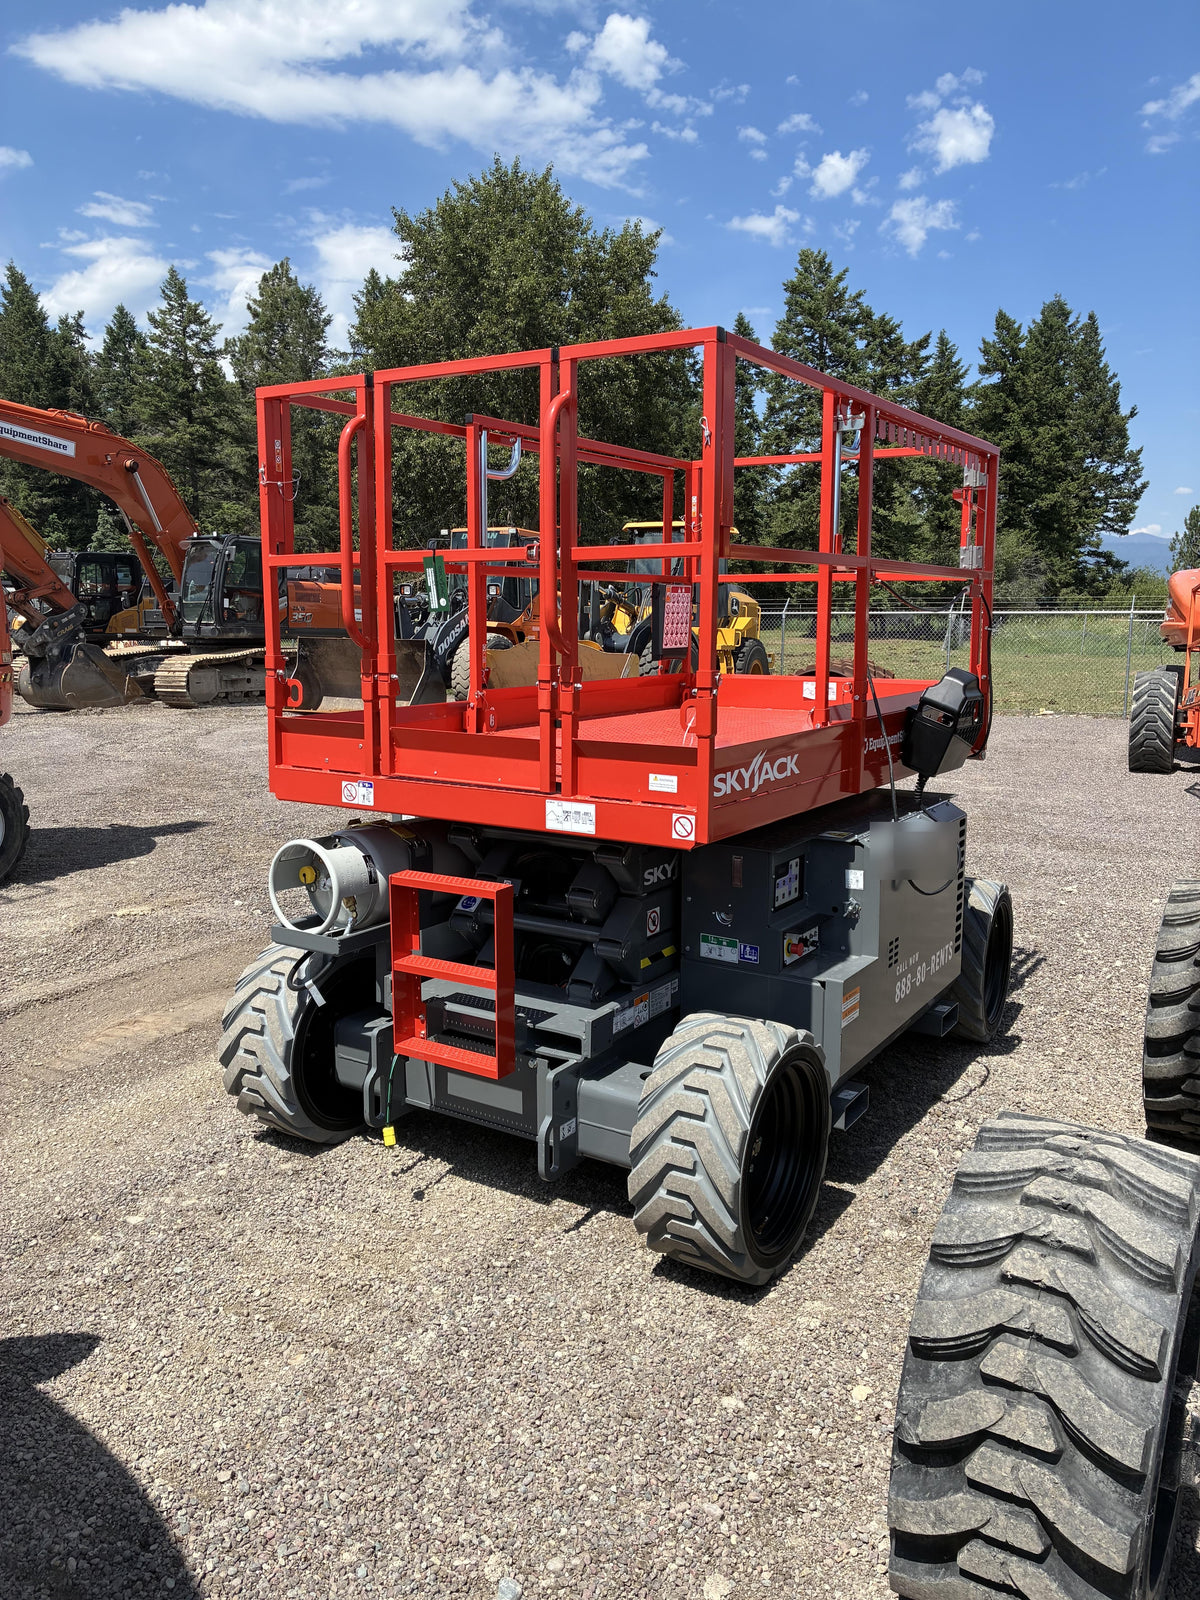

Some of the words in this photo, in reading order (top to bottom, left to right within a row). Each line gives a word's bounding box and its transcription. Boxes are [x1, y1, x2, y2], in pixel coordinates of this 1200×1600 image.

[290, 612, 314, 623] 350
[713, 748, 800, 797] SKYJACK
[895, 941, 953, 1003] 888-80-RENTS
